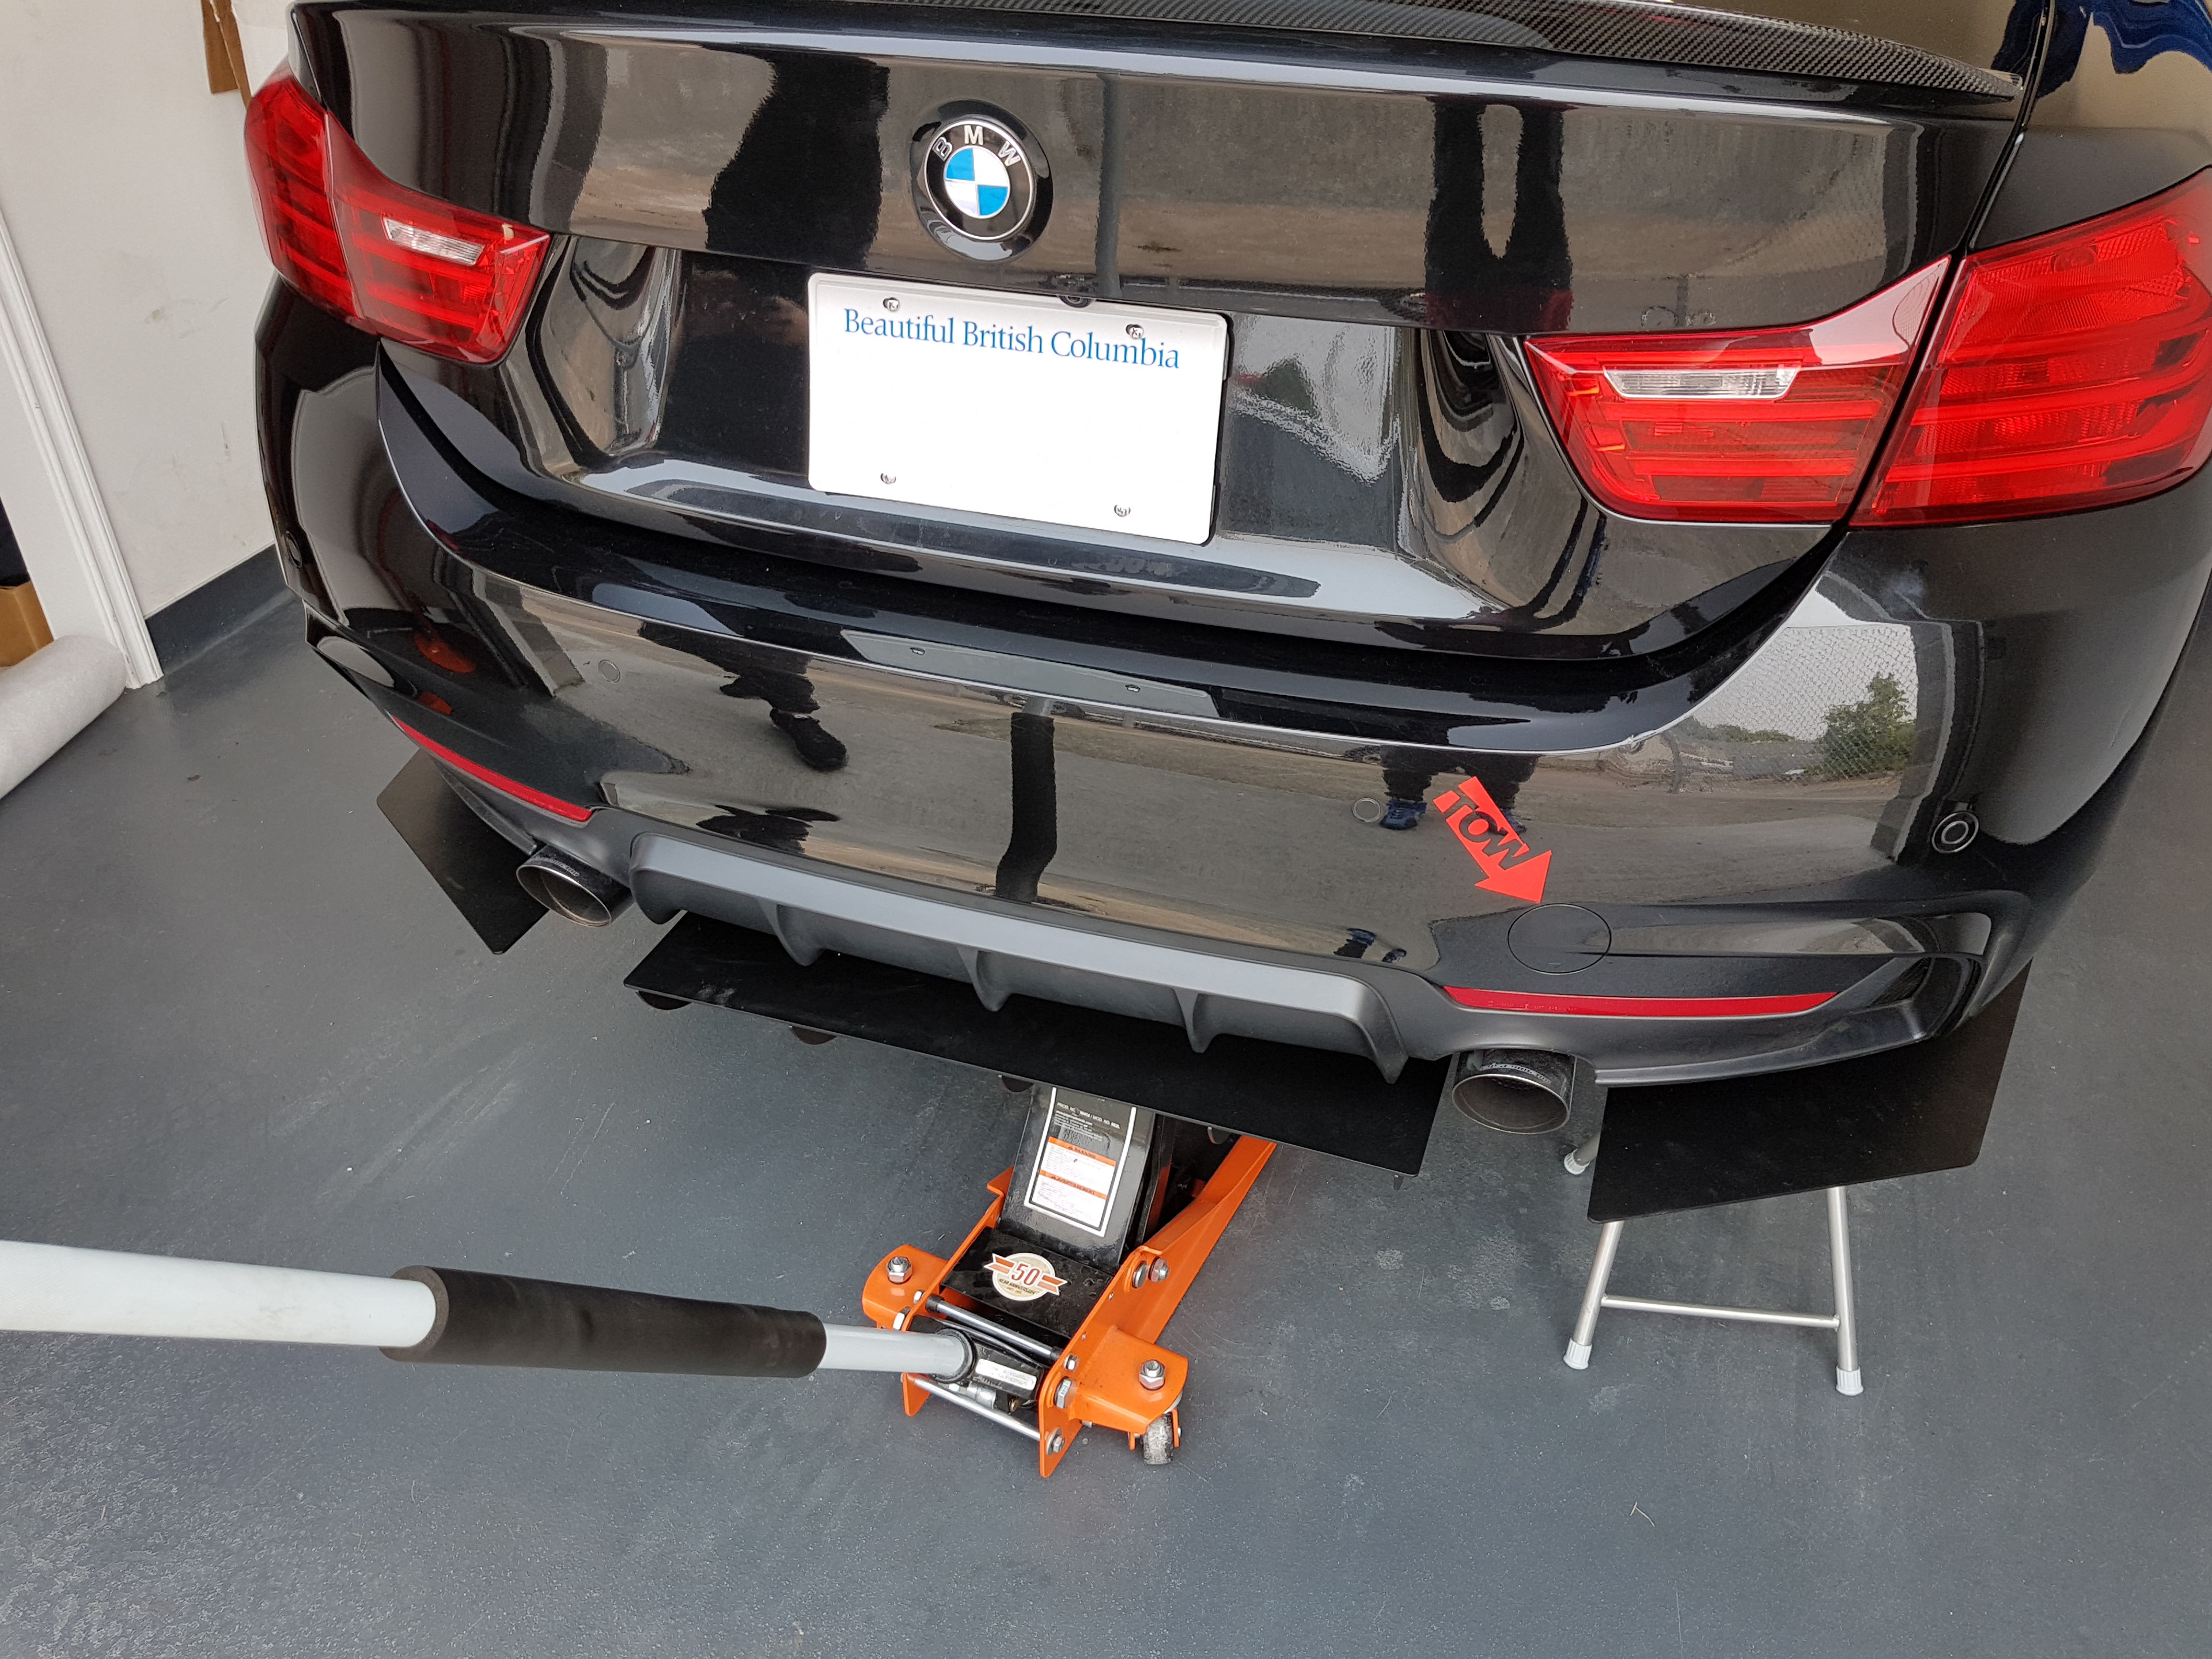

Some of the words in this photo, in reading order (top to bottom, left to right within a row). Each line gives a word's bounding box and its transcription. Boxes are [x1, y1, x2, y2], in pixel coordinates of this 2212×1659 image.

[932, 124, 1021, 167] BMW
[843, 308, 955, 344] Beautiful
[961, 320, 1044, 354] British
[1051, 331, 1180, 369] Columbia
[1440, 785, 1536, 870] TOW
[1011, 1263, 1041, 1286] 50
